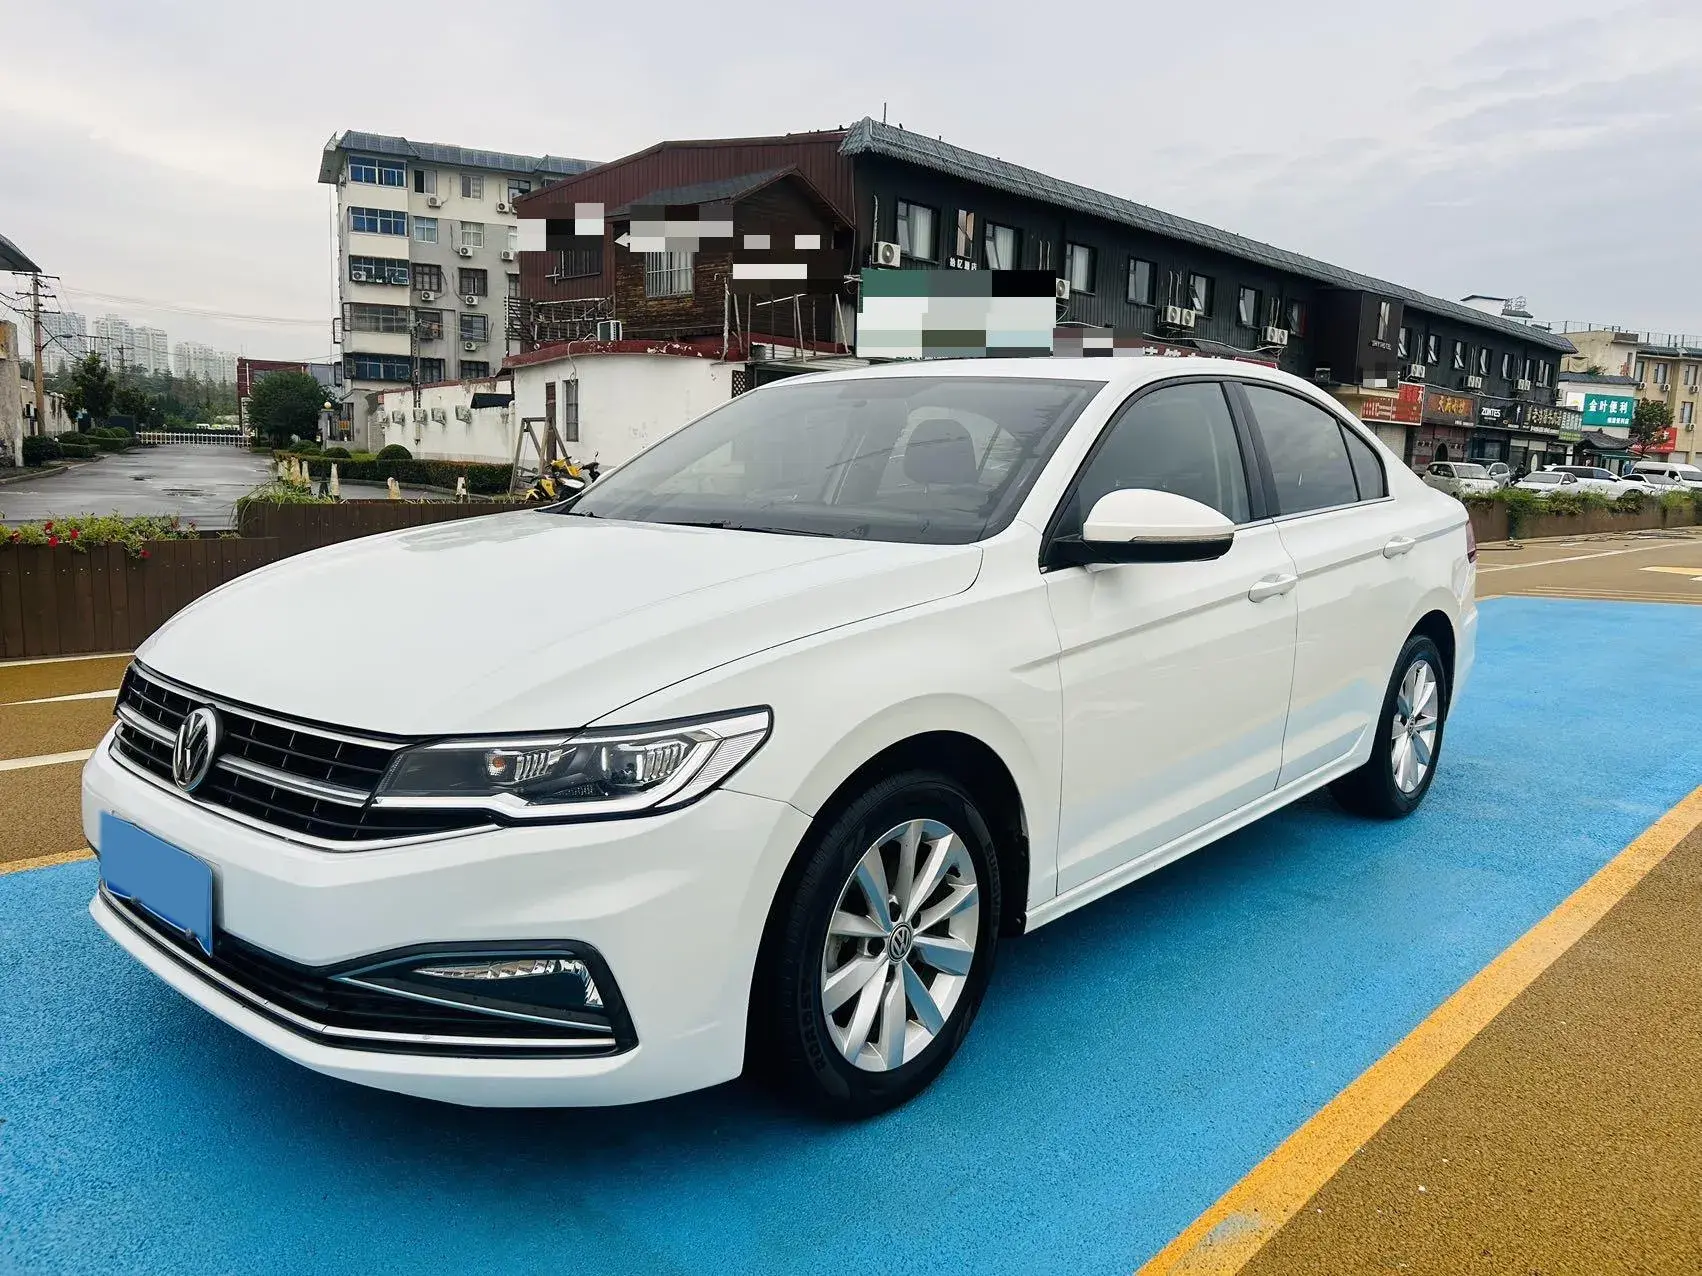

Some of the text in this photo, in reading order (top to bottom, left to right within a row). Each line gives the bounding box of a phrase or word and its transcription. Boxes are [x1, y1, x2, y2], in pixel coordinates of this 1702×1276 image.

[1481, 407, 1501, 418] ZONTES
[1588, 399, 1628, 414] 金叶便利
